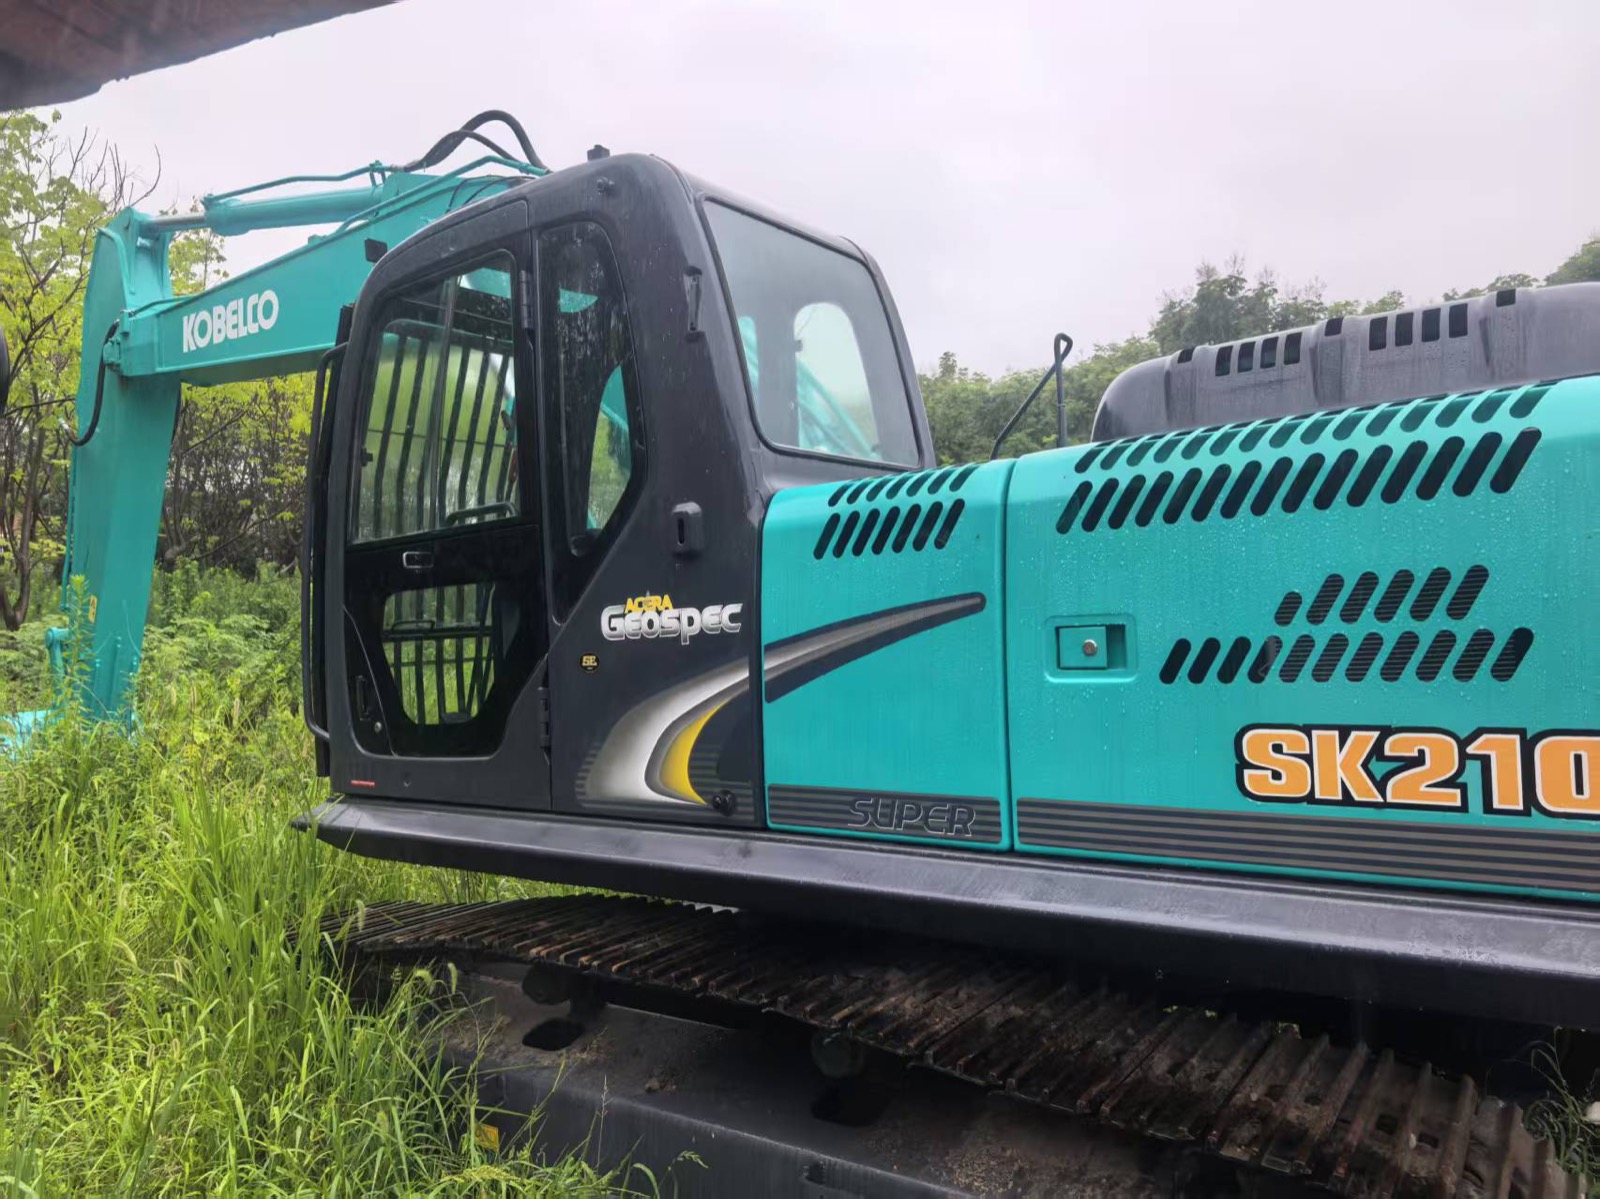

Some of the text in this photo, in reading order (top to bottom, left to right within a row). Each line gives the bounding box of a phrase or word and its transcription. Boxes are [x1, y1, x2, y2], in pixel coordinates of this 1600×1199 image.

[183, 290, 279, 353] KOBELCO
[1234, 723, 1600, 820] SK210
[848, 798, 976, 837] SUPER
